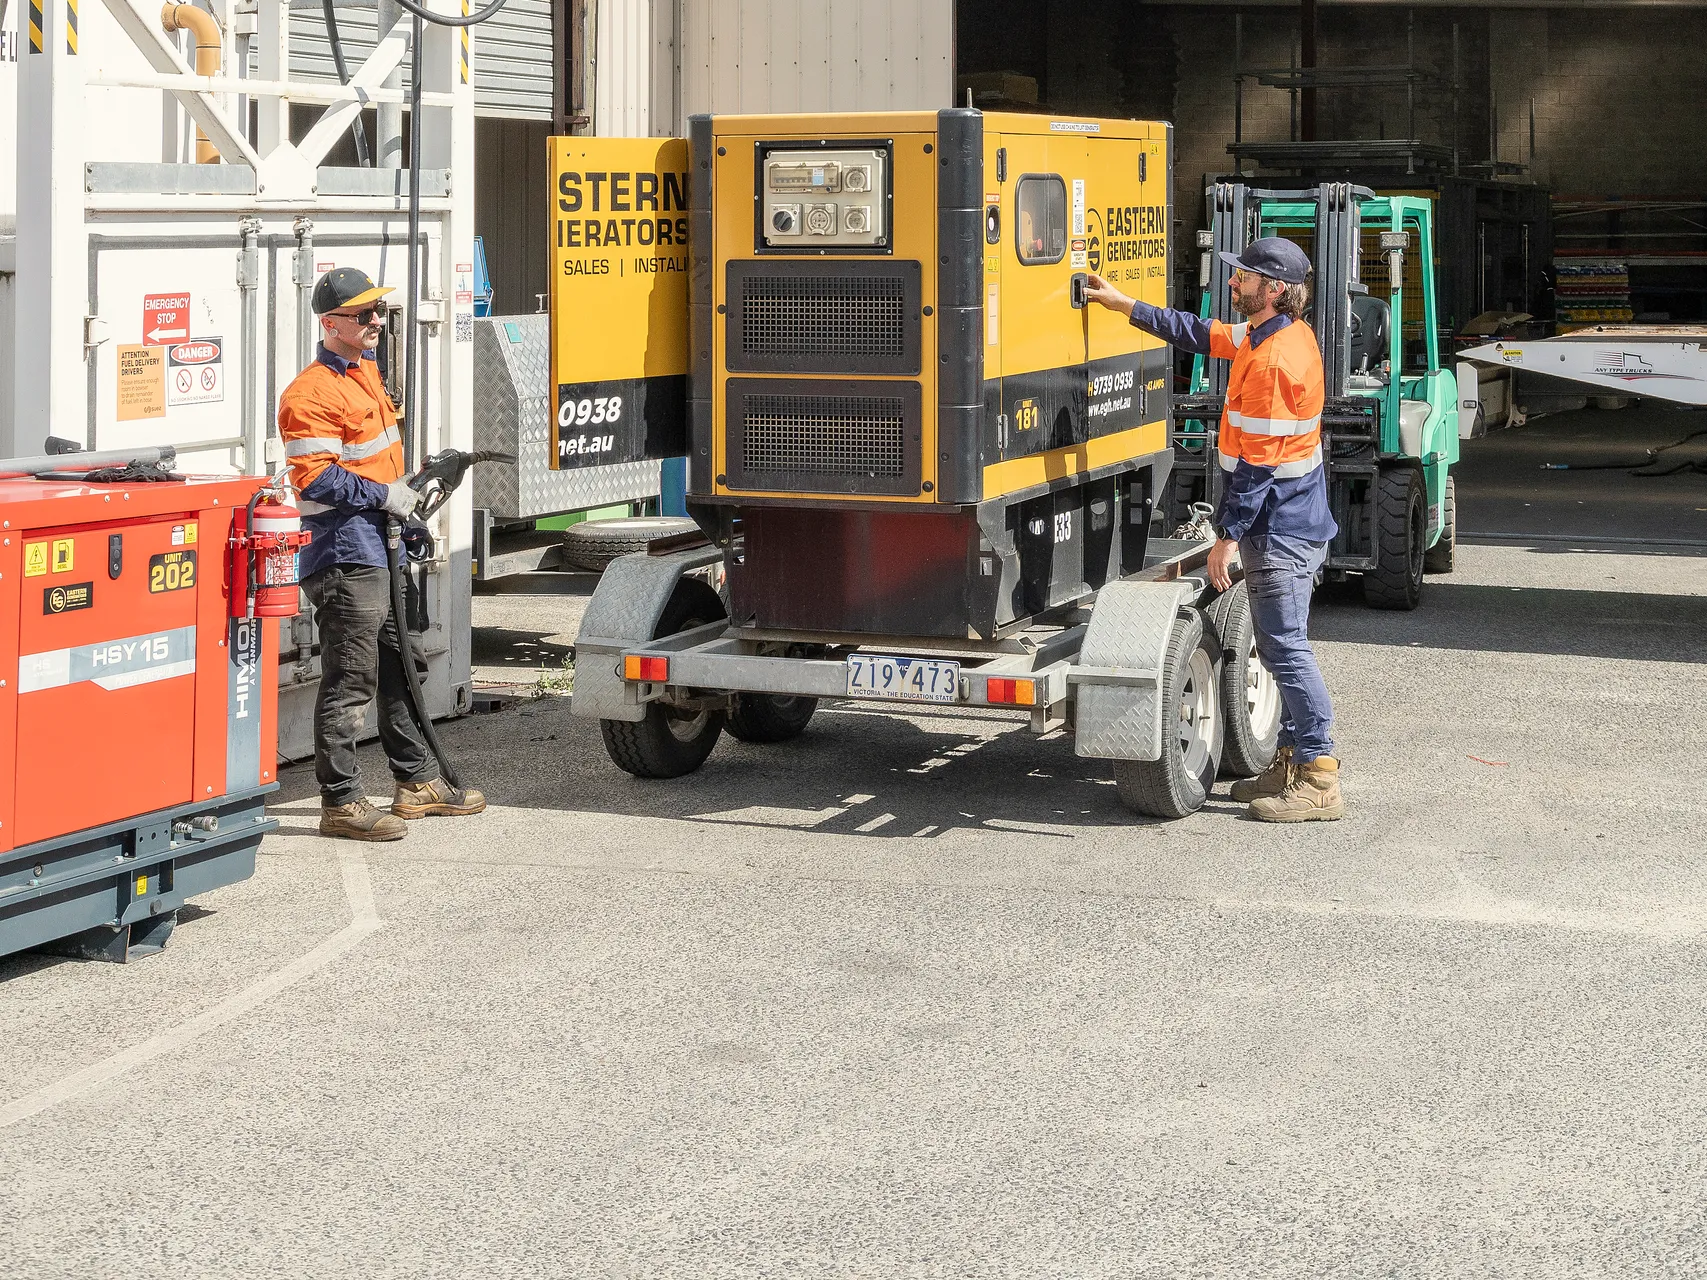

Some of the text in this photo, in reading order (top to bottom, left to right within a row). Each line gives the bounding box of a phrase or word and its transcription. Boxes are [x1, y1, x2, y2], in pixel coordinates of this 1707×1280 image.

[1107, 205, 1165, 237] EASTERN
[1107, 238, 1165, 262] GENERATORS
[564, 259, 610, 276] SALES
[1107, 266, 1165, 282] HIRE SALES INSTALL
[145, 297, 189, 311] EMERGENCY
[156, 312, 176, 325] STOP
[121, 350, 150, 360] ATTENTION
[178, 346, 213, 360] DANGER
[121, 357, 160, 368] FUEL DELIVERY
[121, 367, 144, 376] DRIVERS
[1093, 373, 1113, 395] 9739
[1114, 370, 1134, 391] 0938
[558, 396, 622, 427] 0938
[1015, 406, 1039, 431] 181
[164, 552, 183, 564] UNIT
[151, 560, 194, 593] 202
[92, 635, 169, 668] HSY 15
[851, 661, 955, 694] Z19 473
[853, 688, 954, 702] VICTORIA THE EDUCATION STATE
